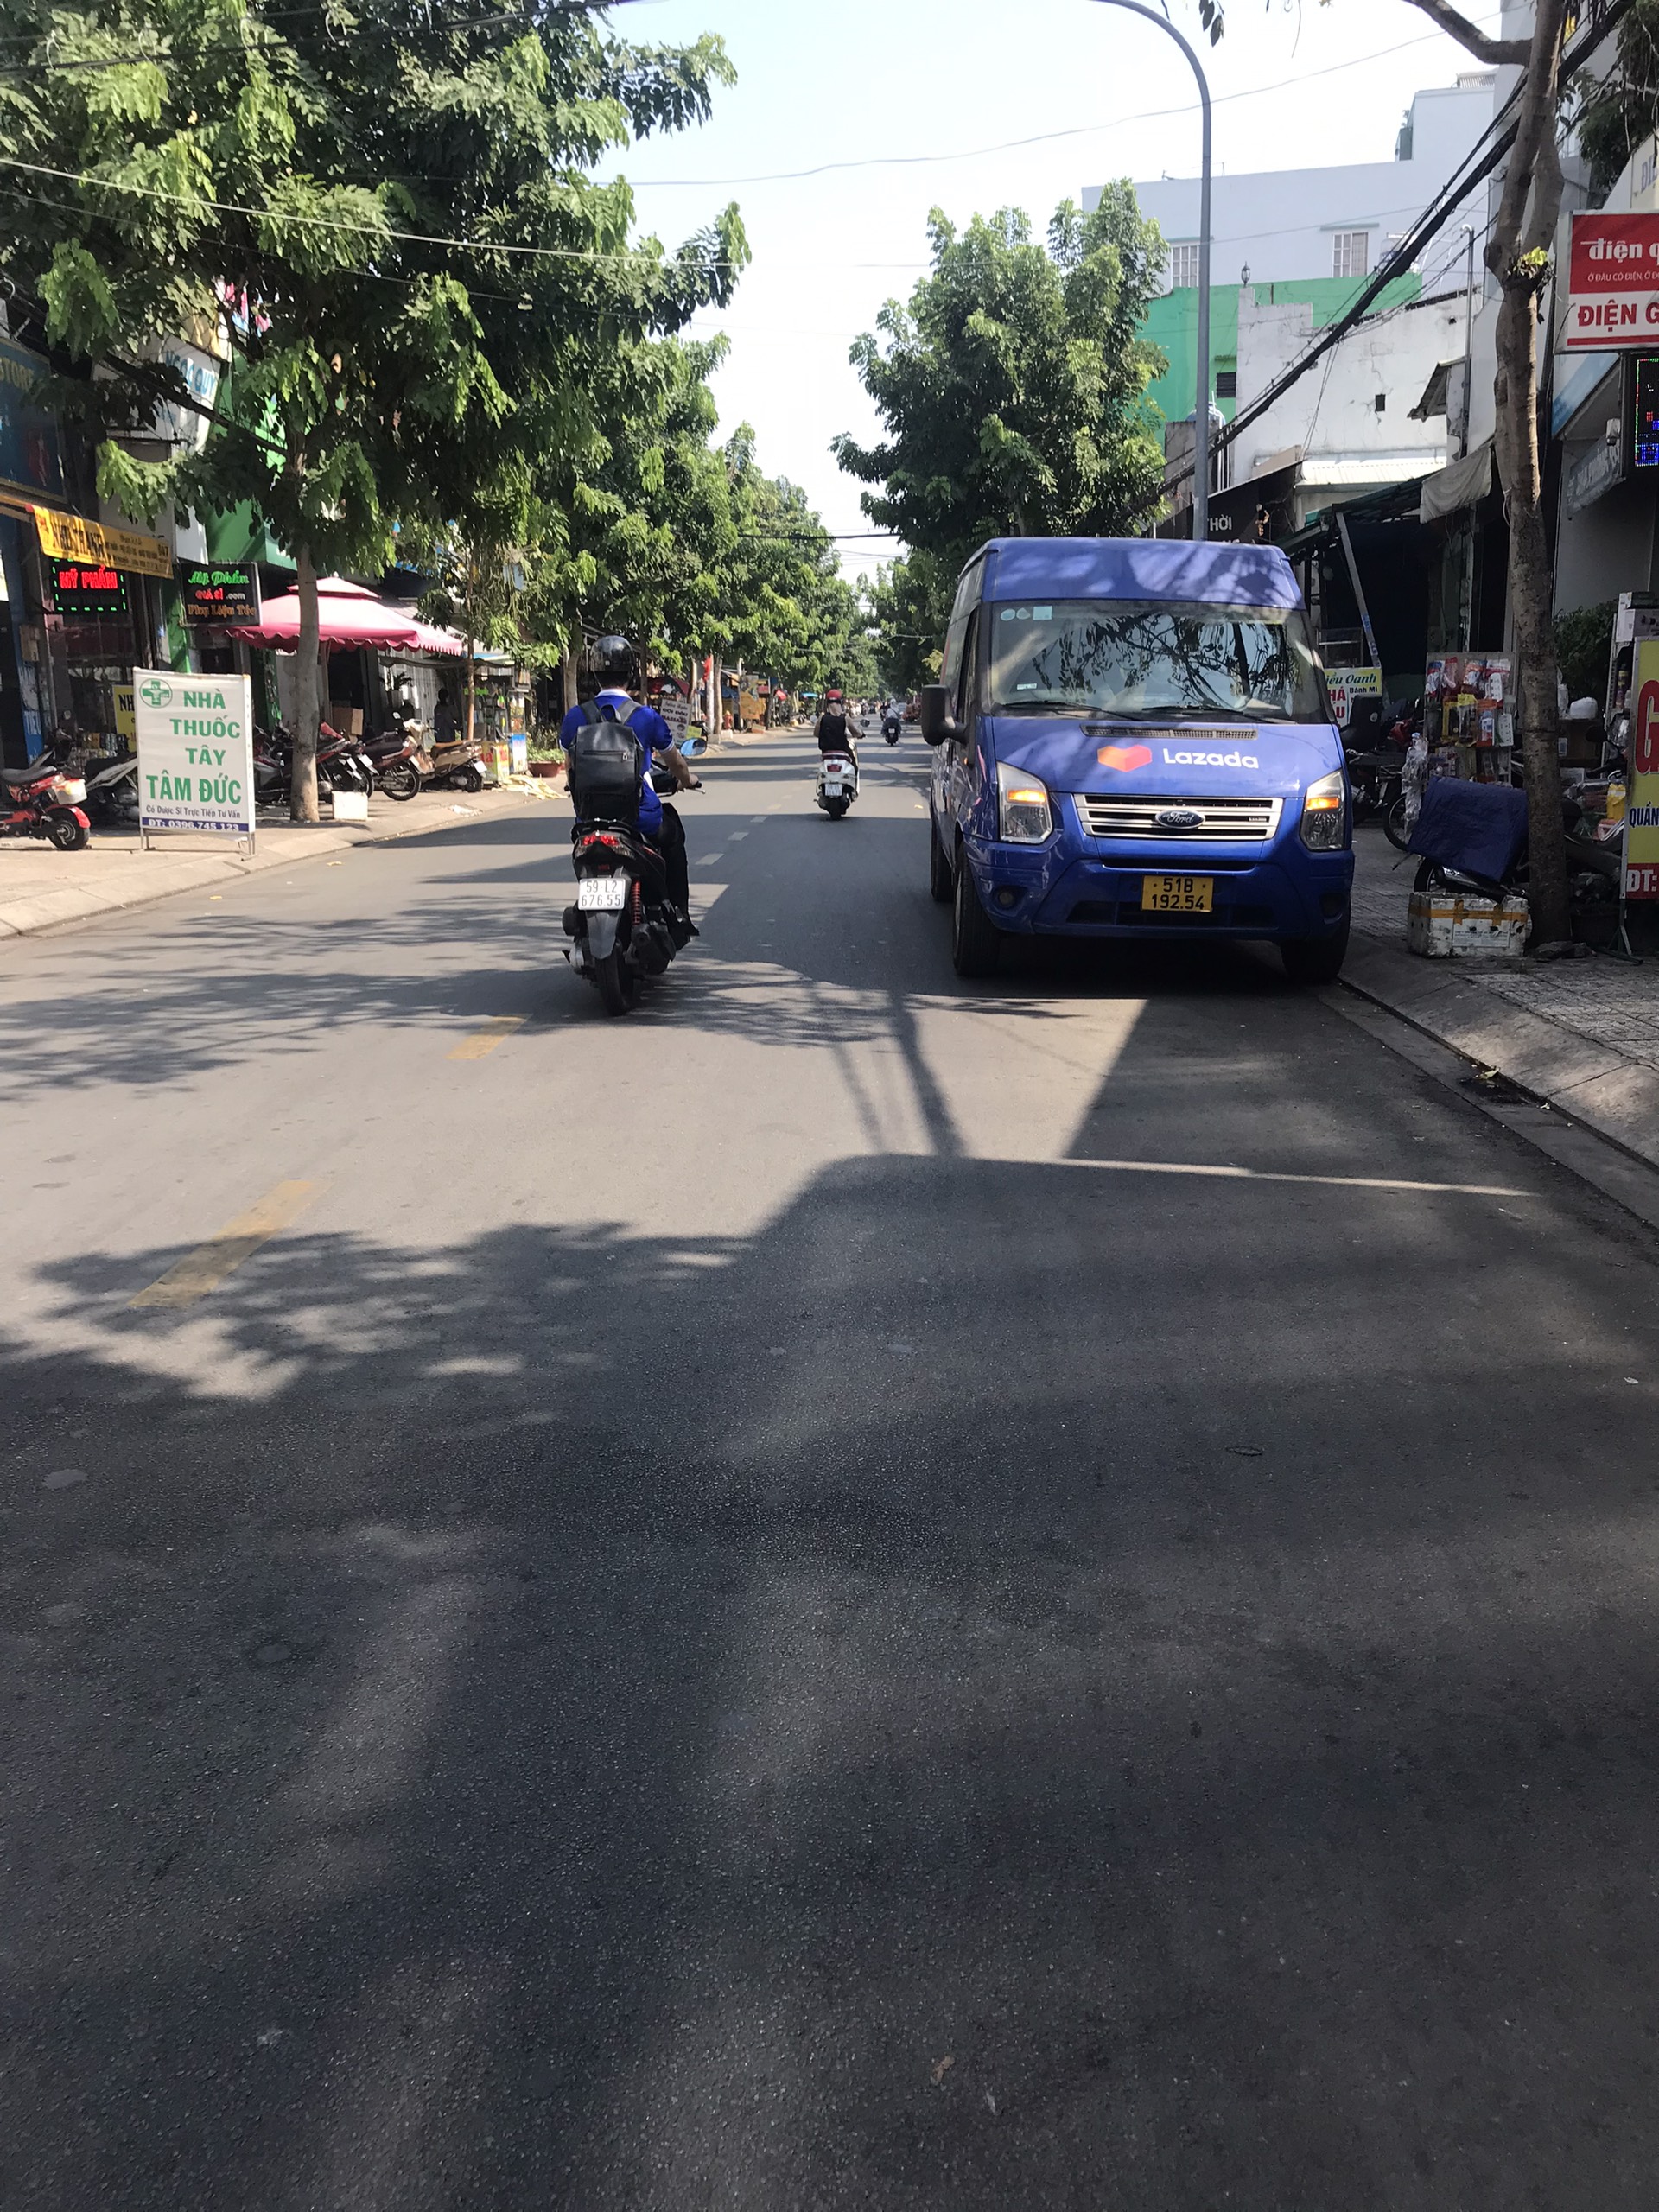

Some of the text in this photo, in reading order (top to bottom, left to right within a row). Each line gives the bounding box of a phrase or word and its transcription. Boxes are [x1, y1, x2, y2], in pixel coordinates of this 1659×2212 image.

[1580, 238, 1643, 263] điện
[1578, 299, 1637, 332] ĐIỆN
[1207, 514, 1232, 531] HỜI
[1345, 673, 1376, 685] Oanh
[183, 688, 226, 709] NHÀ
[1328, 686, 1346, 702] HÁ
[169, 715, 240, 739] THUỐC
[185, 744, 226, 766] TÂY
[1163, 748, 1259, 769] Lazada
[146, 769, 241, 804] TÂM ĐỨC
[146, 804, 156, 813] Có
[156, 805, 174, 815] Dược
[184, 807, 200, 817] Trực
[200, 808, 216, 818] Tiếp
[218, 809, 226, 817] Tư
[227, 809, 241, 818] Vấn
[1166, 810, 1195, 823] Ford
[1163, 878, 1194, 893] 51B
[581, 894, 621, 907] 676.55
[1152, 894, 1205, 911] 192.54
